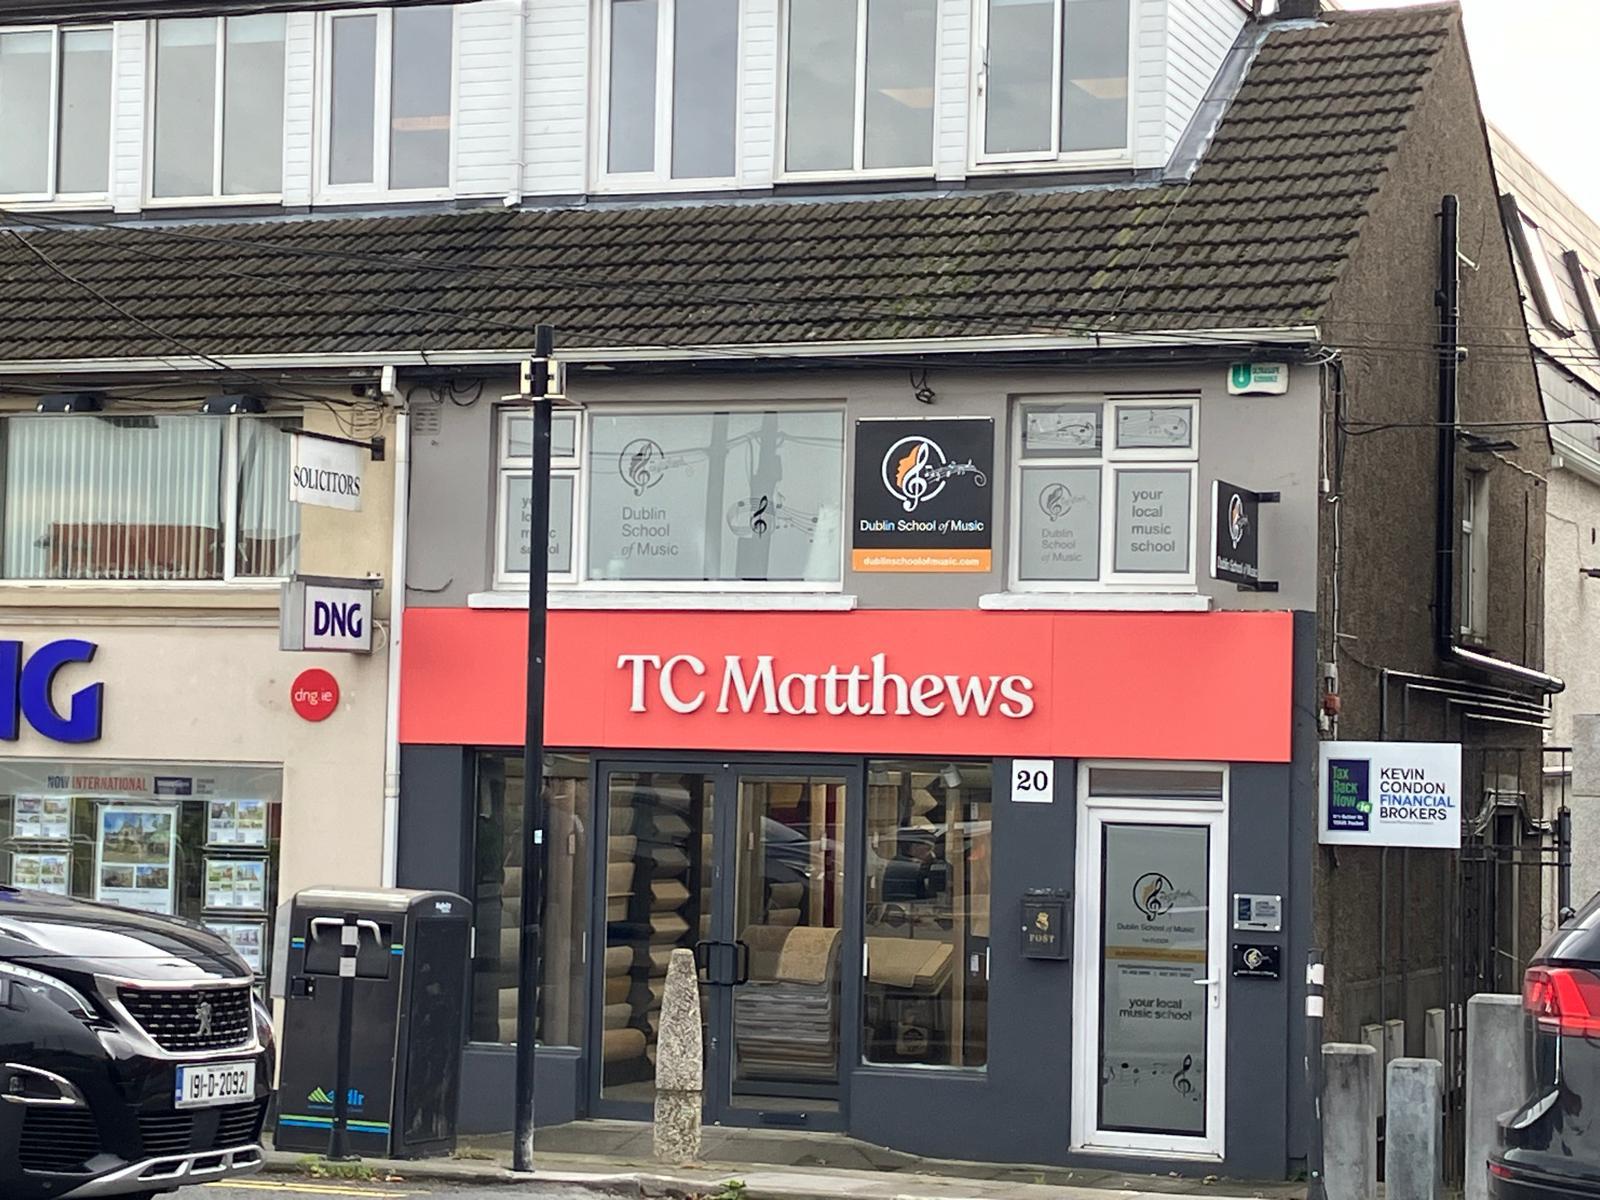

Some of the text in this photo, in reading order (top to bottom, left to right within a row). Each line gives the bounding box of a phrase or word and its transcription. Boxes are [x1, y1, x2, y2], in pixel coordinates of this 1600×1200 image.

[293, 465, 361, 497] SOLICITORS
[1132, 489, 1163, 503] your
[621, 507, 666, 520] Dublin
[1132, 505, 1163, 518] local
[621, 523, 670, 537] School
[860, 520, 984, 535] Dublin School of Music
[1041, 528, 1073, 538] Dublin
[1131, 522, 1172, 535] music
[621, 542, 679, 559] of Music
[1041, 539, 1076, 550] School
[1131, 539, 1176, 552] school
[863, 556, 980, 567] dublinschoolofmusic.com
[1052, 551, 1082, 562] Music
[313, 601, 363, 638] DNG
[617, 652, 1035, 718] TC Matthews
[294, 685, 333, 705] dng.ie
[1332, 766, 1349, 779] Tax
[1380, 767, 1425, 780] KEVIN
[48, 776, 69, 789] NOW
[72, 776, 147, 791] INTERNATIONAL
[1016, 770, 1048, 792] 20
[1333, 780, 1358, 793] Back
[1380, 781, 1446, 794] CONDON
[1333, 794, 1356, 807] Now
[1380, 794, 1456, 808] FINANCIAL
[1380, 807, 1447, 820] BROKERS
[1116, 922, 1139, 930] Dublin
[1029, 933, 1055, 944] POST
[1128, 998, 1182, 1009] your local
[1119, 1009, 1192, 1020] music school
[190, 1070, 248, 1098] 191-D-20921
